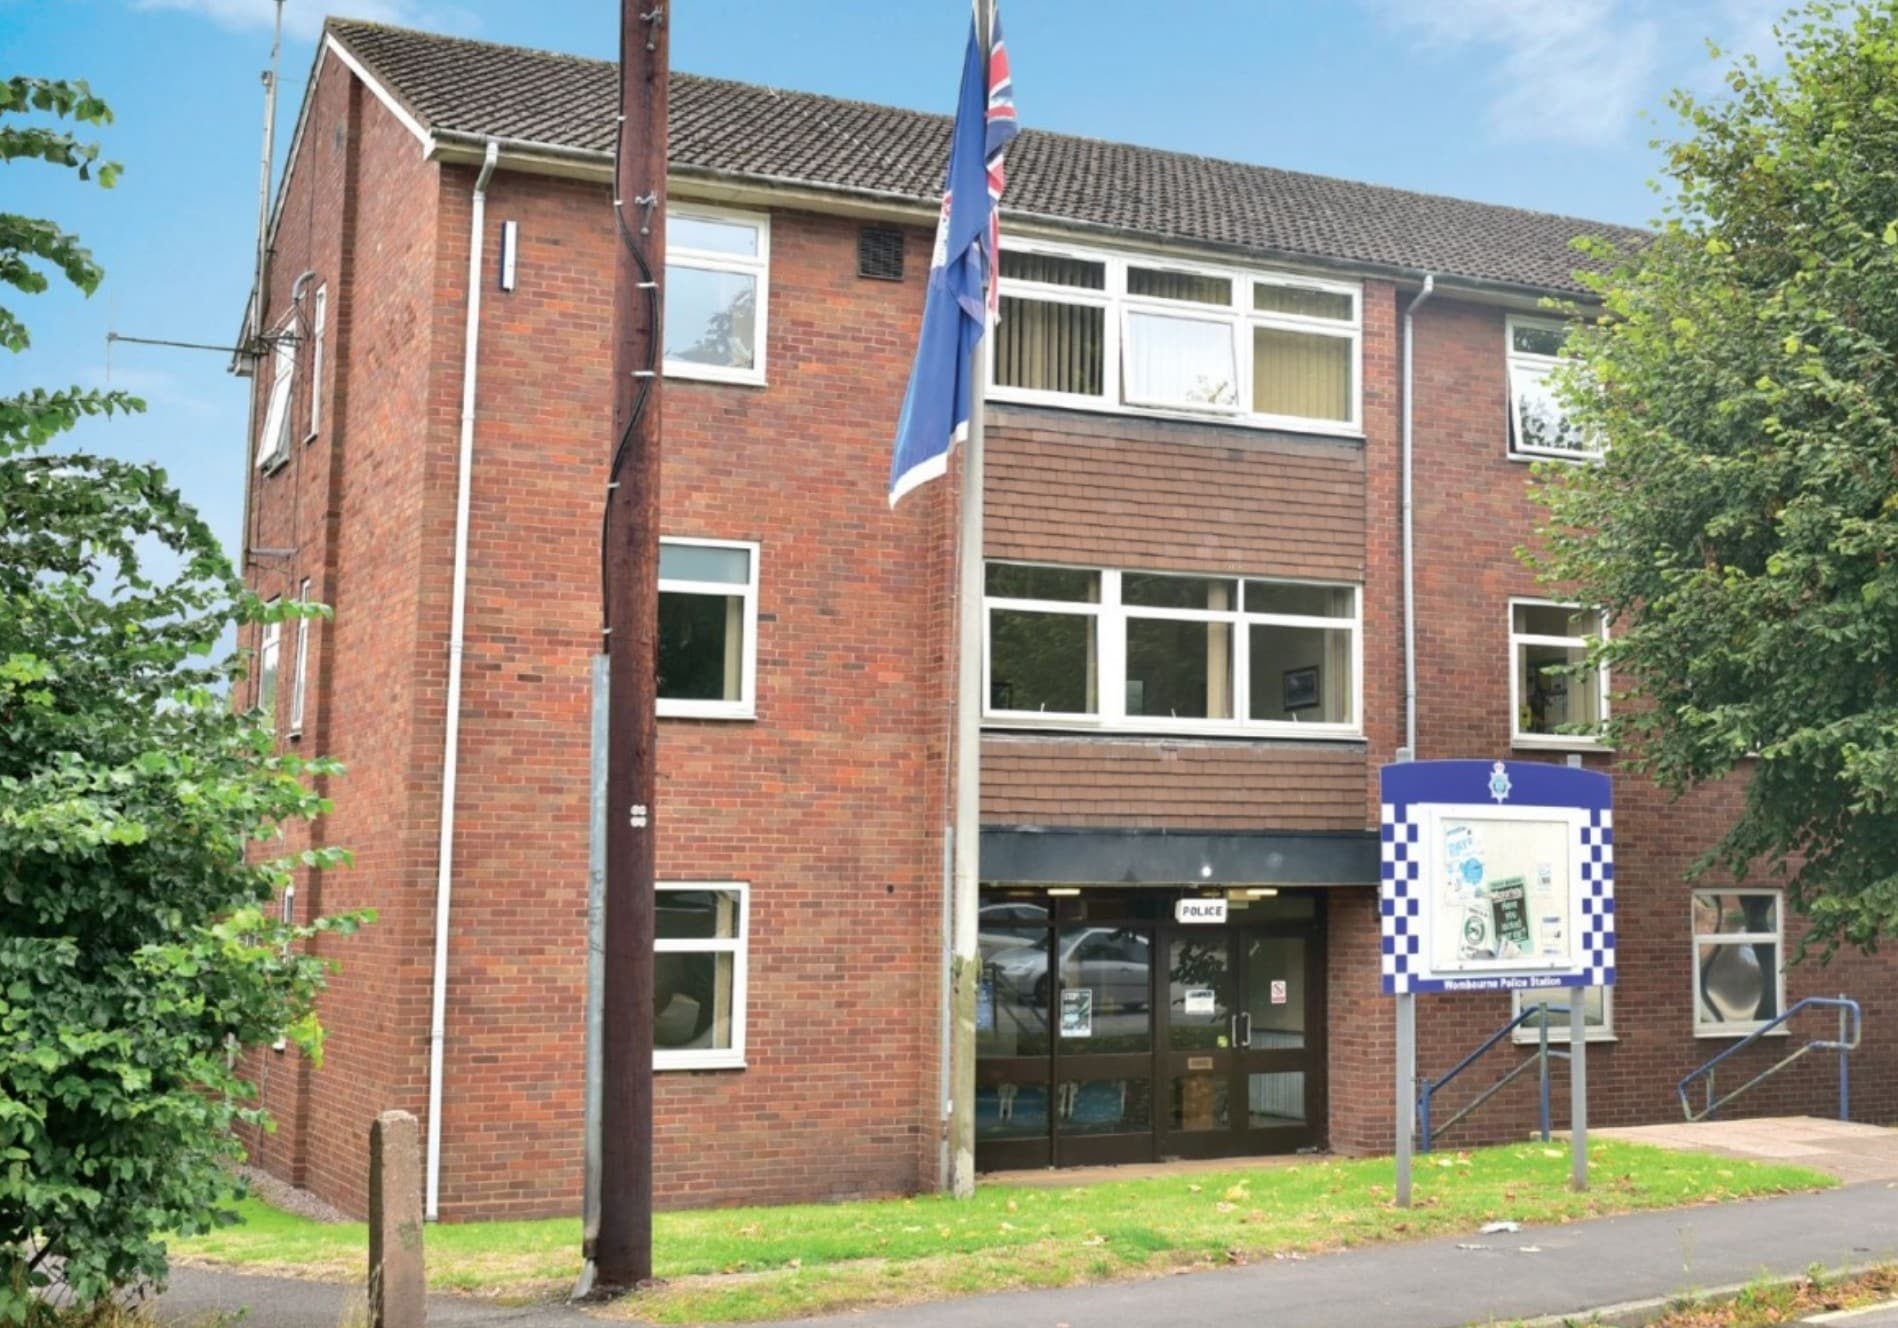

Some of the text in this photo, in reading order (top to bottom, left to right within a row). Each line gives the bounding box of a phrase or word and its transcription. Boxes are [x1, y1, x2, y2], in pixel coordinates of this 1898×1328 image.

[1183, 905, 1224, 917] POLICE
[1444, 976, 1561, 990] Wombourne Police Station
